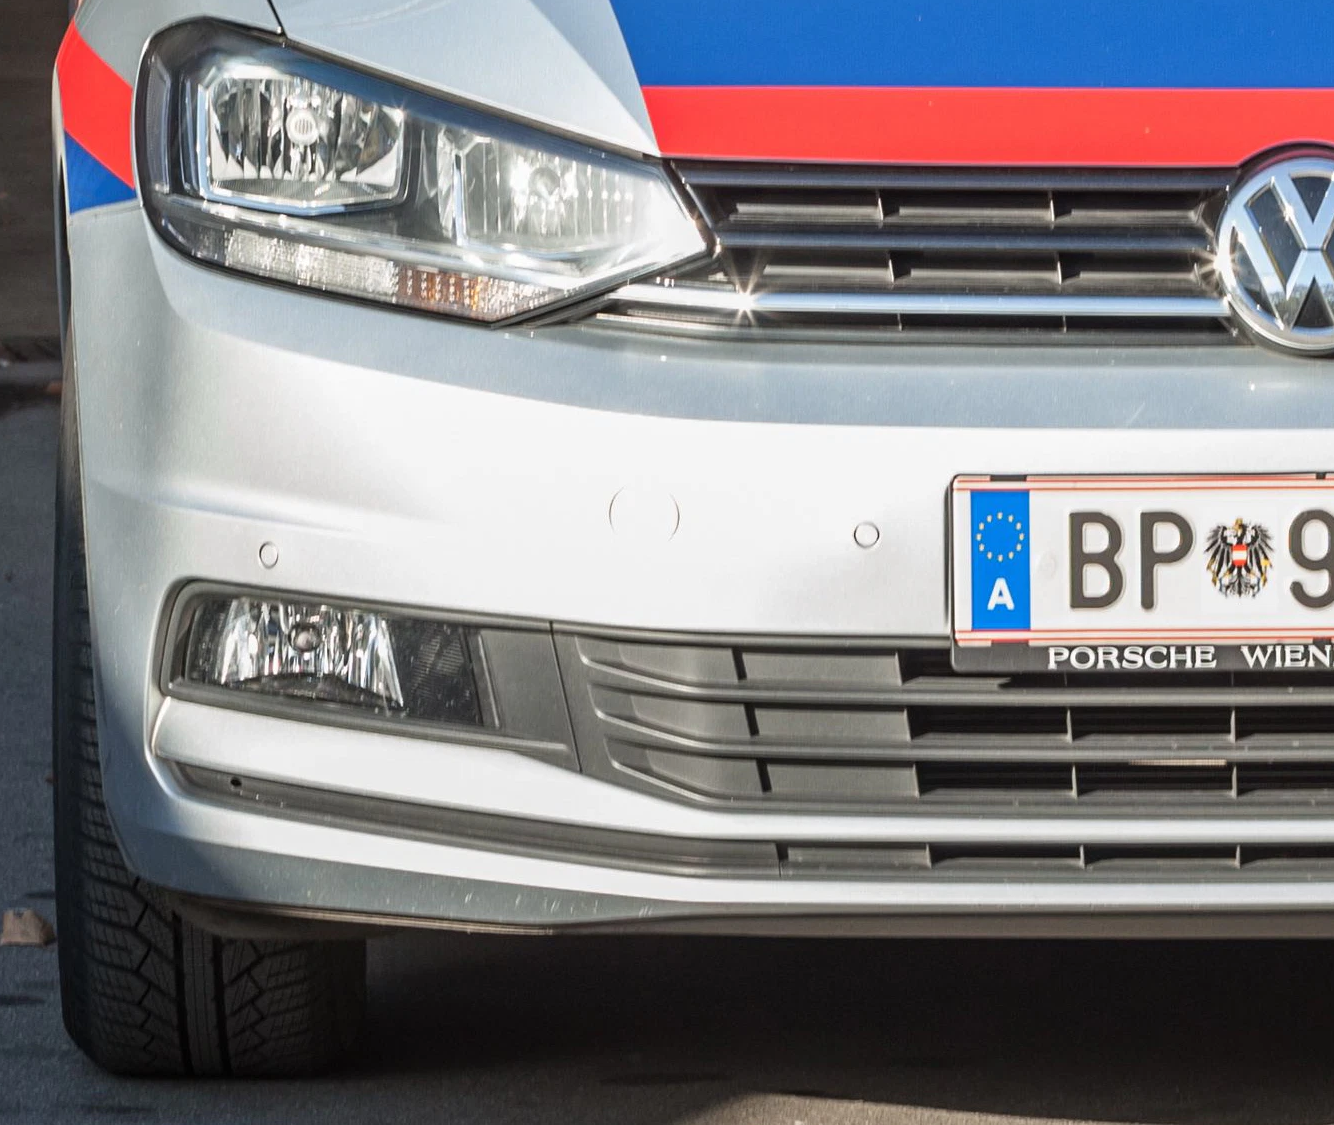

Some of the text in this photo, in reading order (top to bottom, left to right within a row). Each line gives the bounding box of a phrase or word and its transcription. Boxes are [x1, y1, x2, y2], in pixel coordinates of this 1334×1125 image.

[1068, 510, 1195, 611] BP
[988, 578, 1014, 610] A
[1047, 645, 1218, 670] PORSCHE
